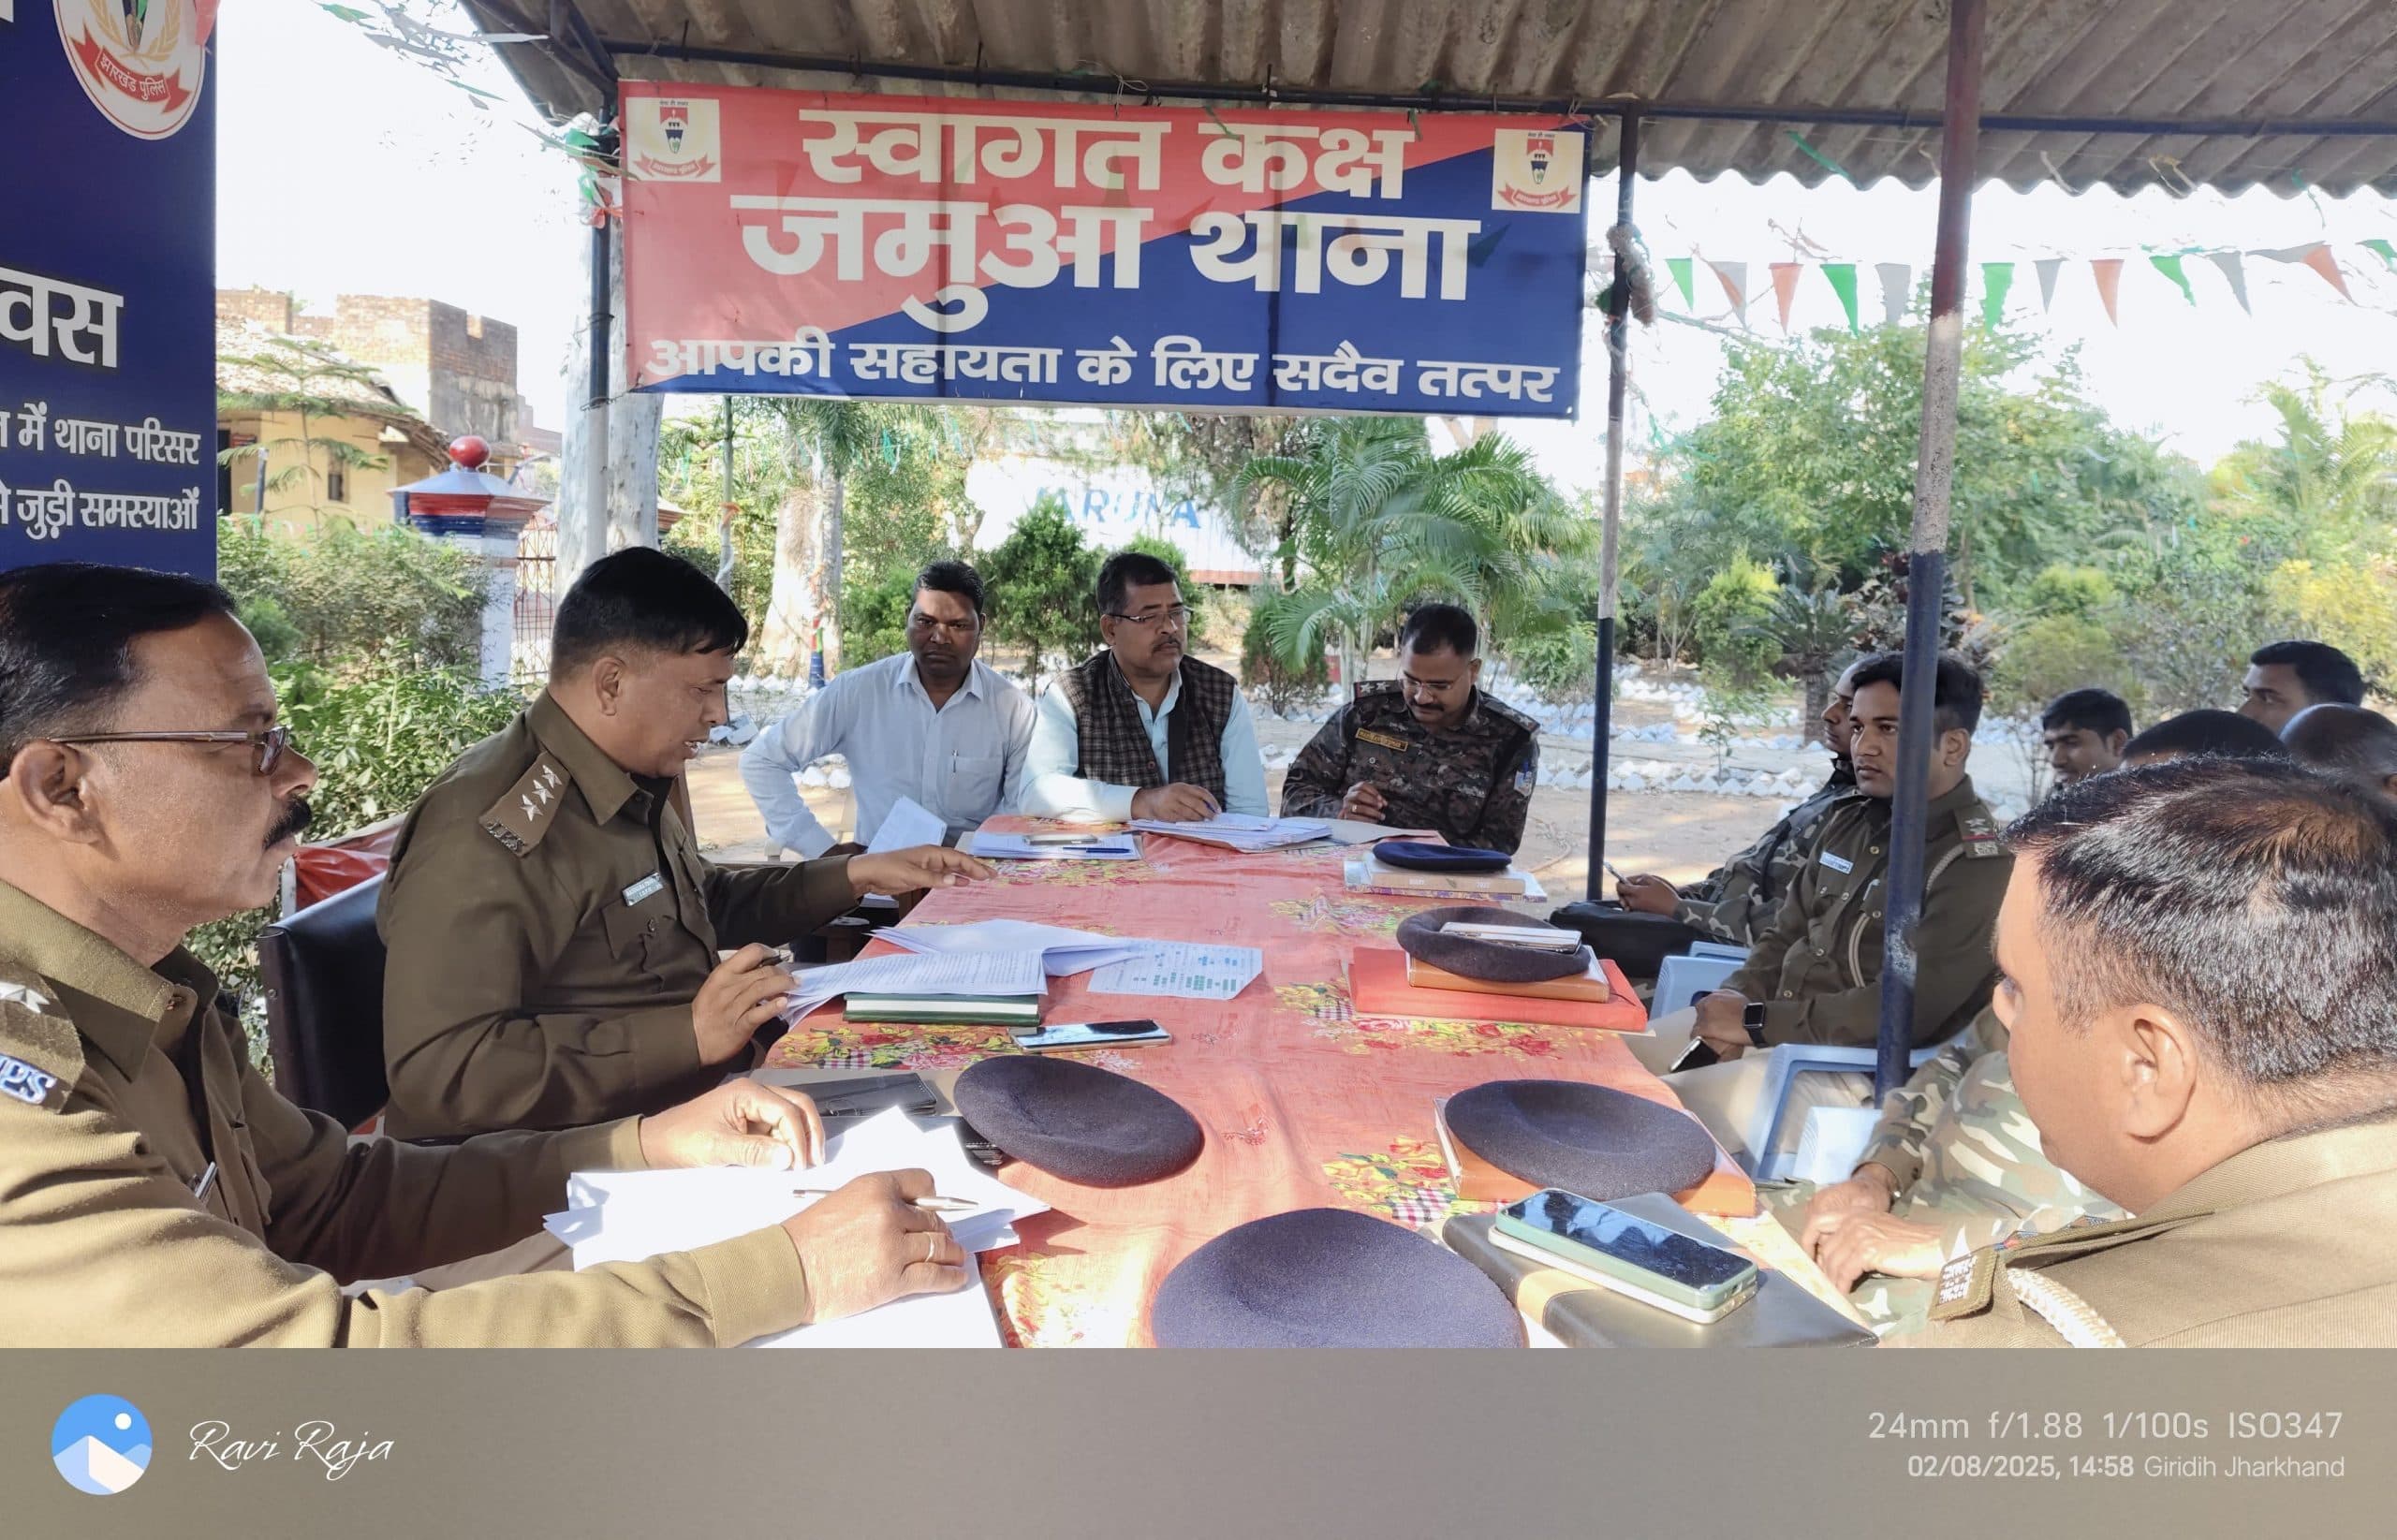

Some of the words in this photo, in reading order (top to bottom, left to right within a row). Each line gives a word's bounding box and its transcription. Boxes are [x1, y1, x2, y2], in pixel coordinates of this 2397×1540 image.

[100, 53, 137, 92] झारखंड
[140, 77, 166, 100] पुलिस
[799, 109, 1172, 191] स्वागत
[1198, 122, 1429, 199] कक्ष
[729, 194, 1154, 332] जमुआ
[1189, 209, 1482, 301] थाना
[645, 325, 836, 378] आपकी
[848, 342, 1064, 385] सहायता
[1076, 335, 1138, 385] के
[1151, 334, 1259, 391] लिए
[1272, 340, 1404, 394] सदैव
[1417, 360, 1561, 403] तत्पर
[17, 401, 47, 451] में
[54, 418, 119, 458] थाना
[124, 417, 201, 464] परिसर
[16, 478, 76, 540] जुड़ी
[79, 486, 200, 530] समस्याओं
